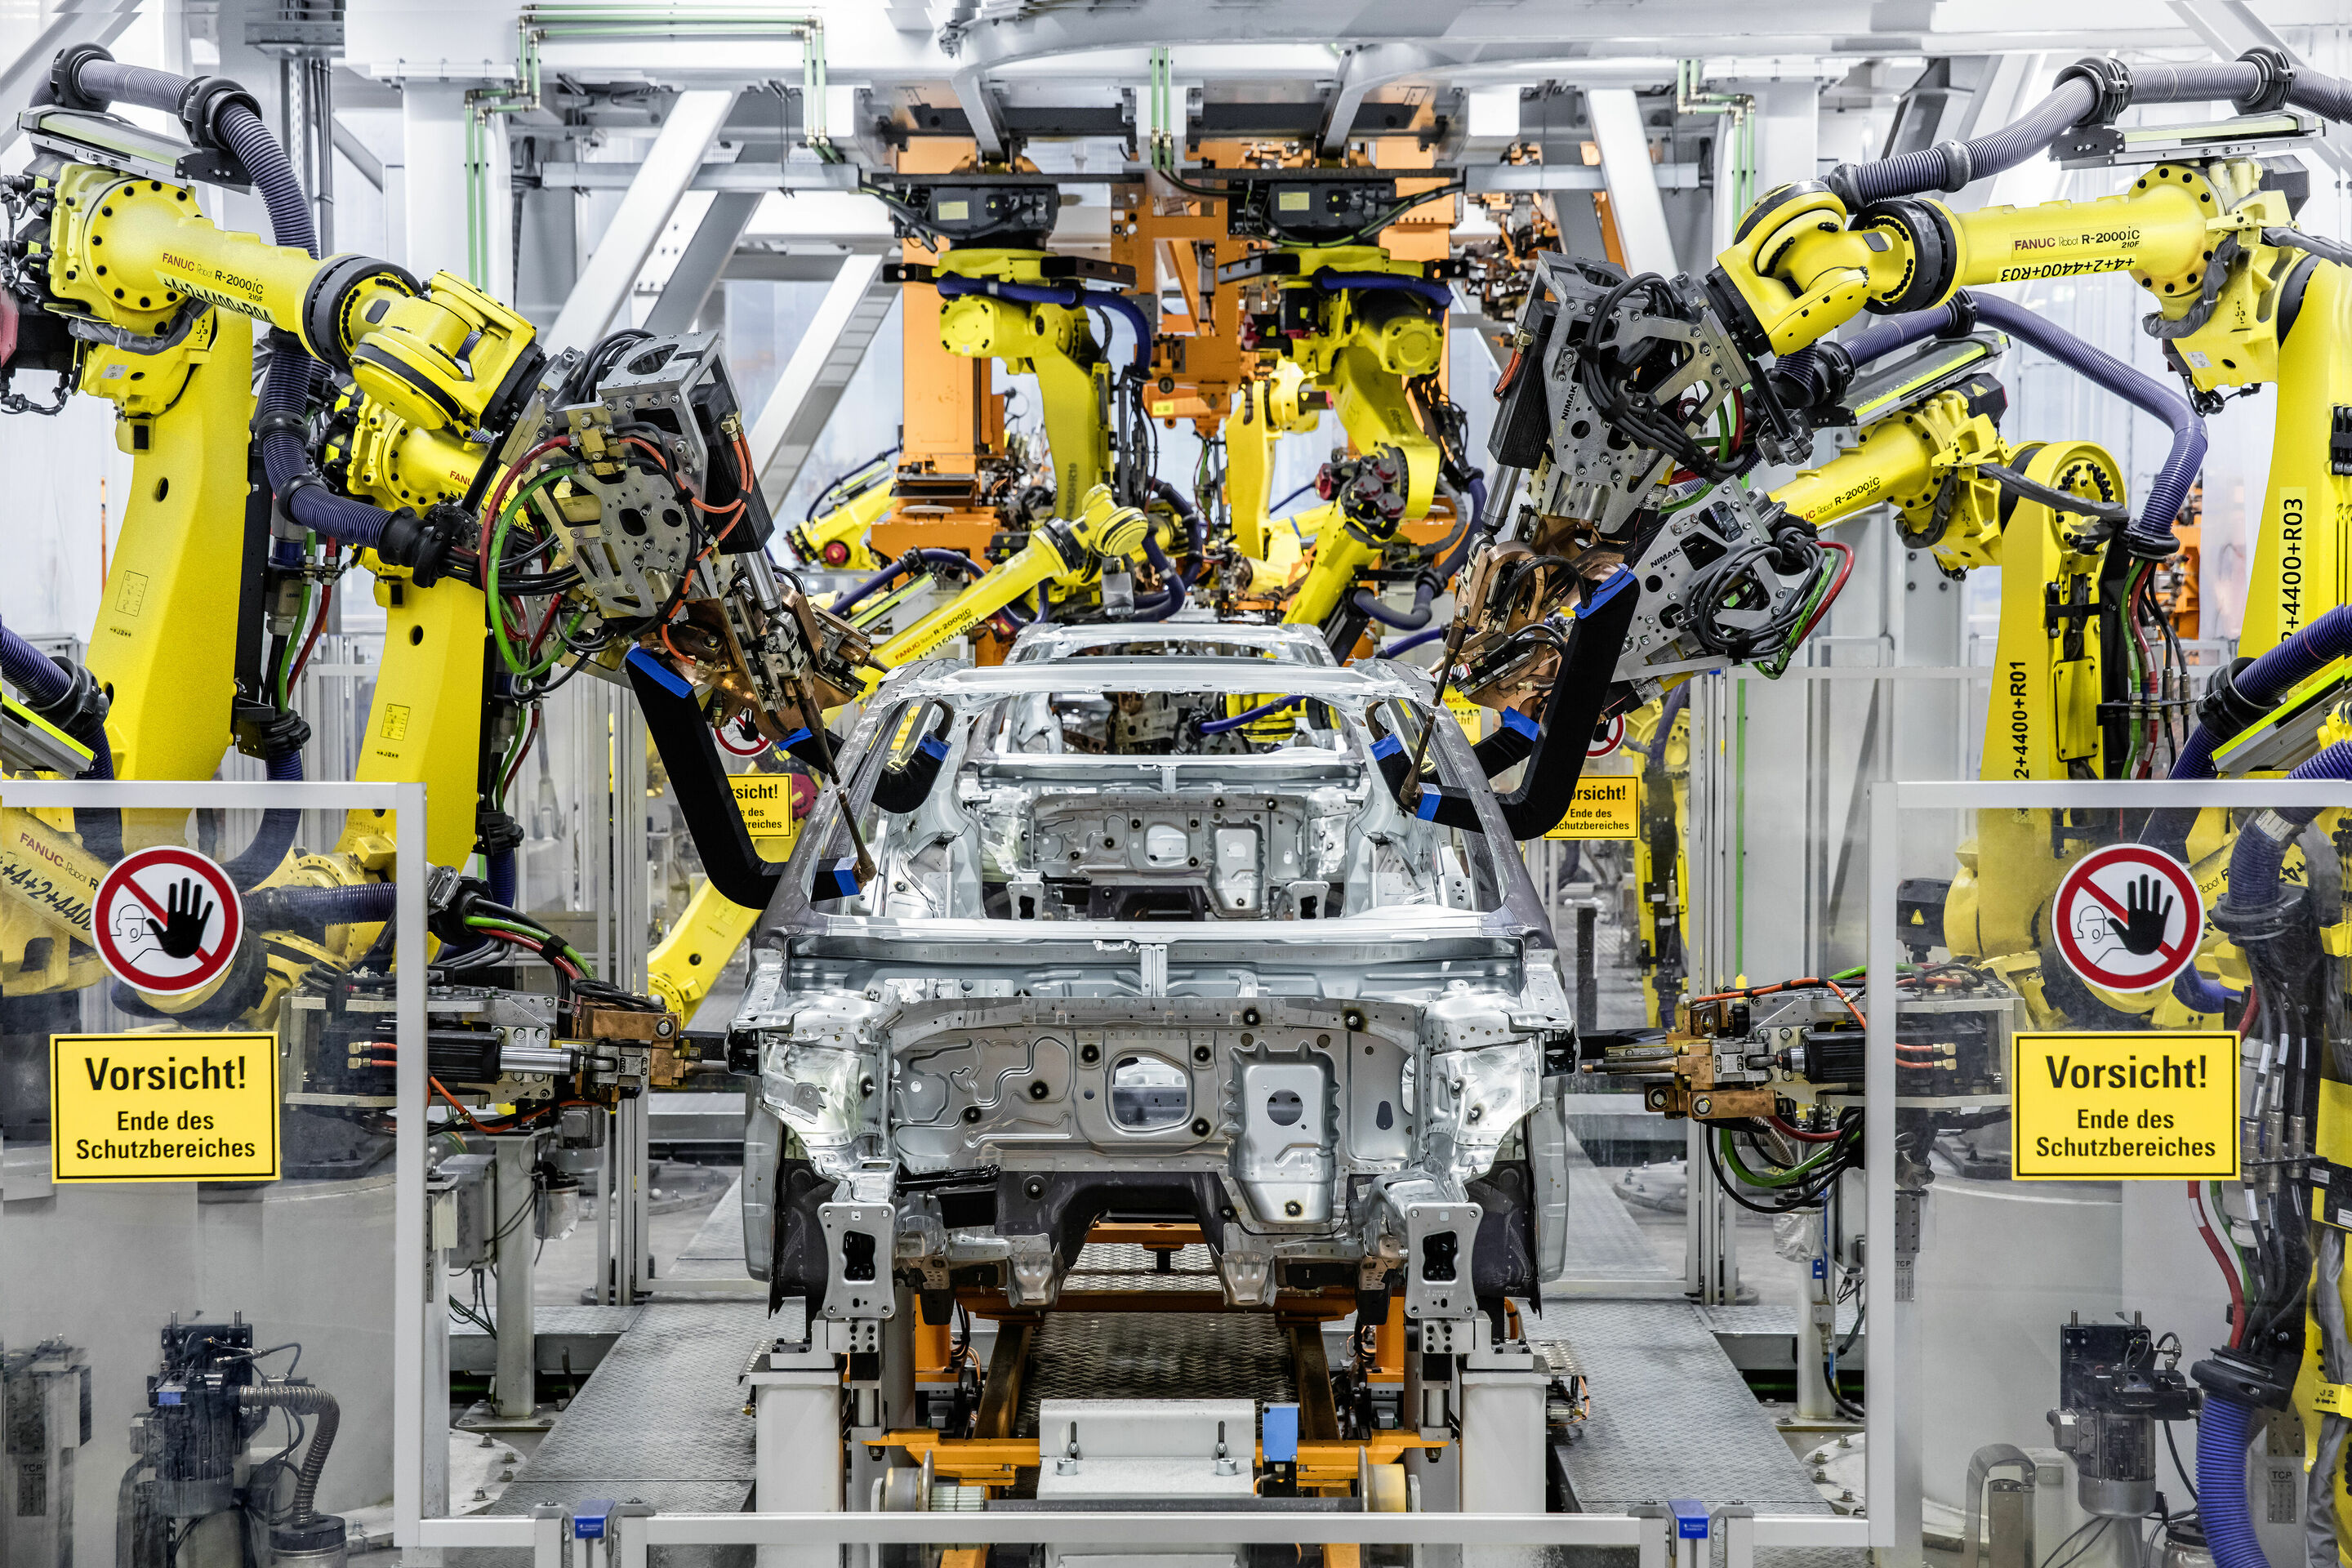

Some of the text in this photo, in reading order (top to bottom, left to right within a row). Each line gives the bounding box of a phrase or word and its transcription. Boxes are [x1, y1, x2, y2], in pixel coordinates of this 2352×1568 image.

[2014, 225, 2140, 251] FANUC Robot R-2000iC
[2121, 240, 2140, 249] 210F
[162, 252, 264, 295] FANUC Robot R-2000iC
[247, 292, 263, 303] 210F
[1561, 384, 1578, 421] NIMAK
[449, 470, 470, 487] FAN
[1817, 476, 1881, 515] Robot R-2000iC
[1650, 546, 1681, 568] NIMAK
[895, 640, 921, 661] FANUC
[732, 784, 777, 800] sicht!
[1572, 785, 1625, 800] rsicht!
[748, 807, 764, 817] des
[1570, 808, 1612, 818] Ende des
[20, 832, 87, 883] FANUC Robot
[85, 1056, 245, 1091] Vorsicht!
[2045, 1054, 2207, 1089] Vorsicht!
[117, 1110, 215, 1131] Ende des
[2077, 1109, 2175, 1129] Ende des
[76, 1138, 256, 1160] Schutzbereiches
[2036, 1136, 2216, 1157] Schutzbereiches
[23, 1463, 43, 1472] TCP
[2271, 1471, 2293, 1480] TCP
